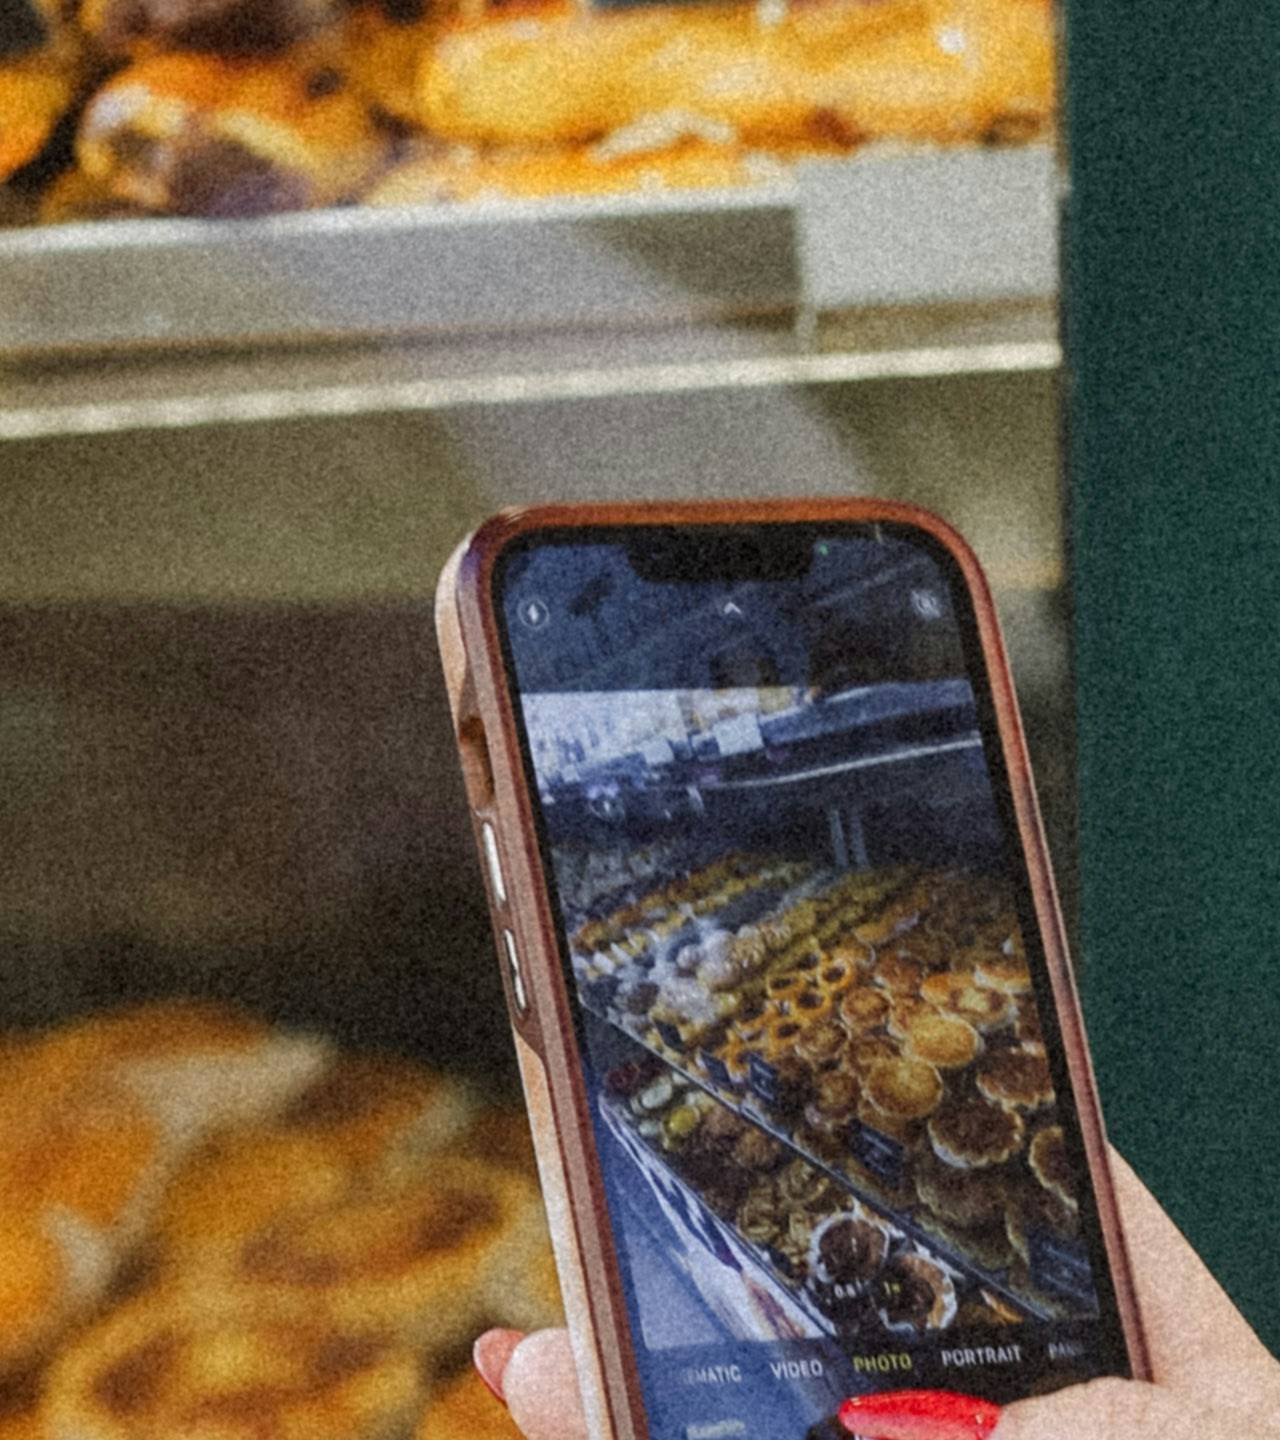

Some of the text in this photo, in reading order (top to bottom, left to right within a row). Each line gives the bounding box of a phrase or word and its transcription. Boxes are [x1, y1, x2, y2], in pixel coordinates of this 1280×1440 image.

[770, 1359, 823, 1381] VIDEO
[853, 1353, 912, 1373] PHOTO
[941, 1344, 1021, 1367] PORTRAIT
